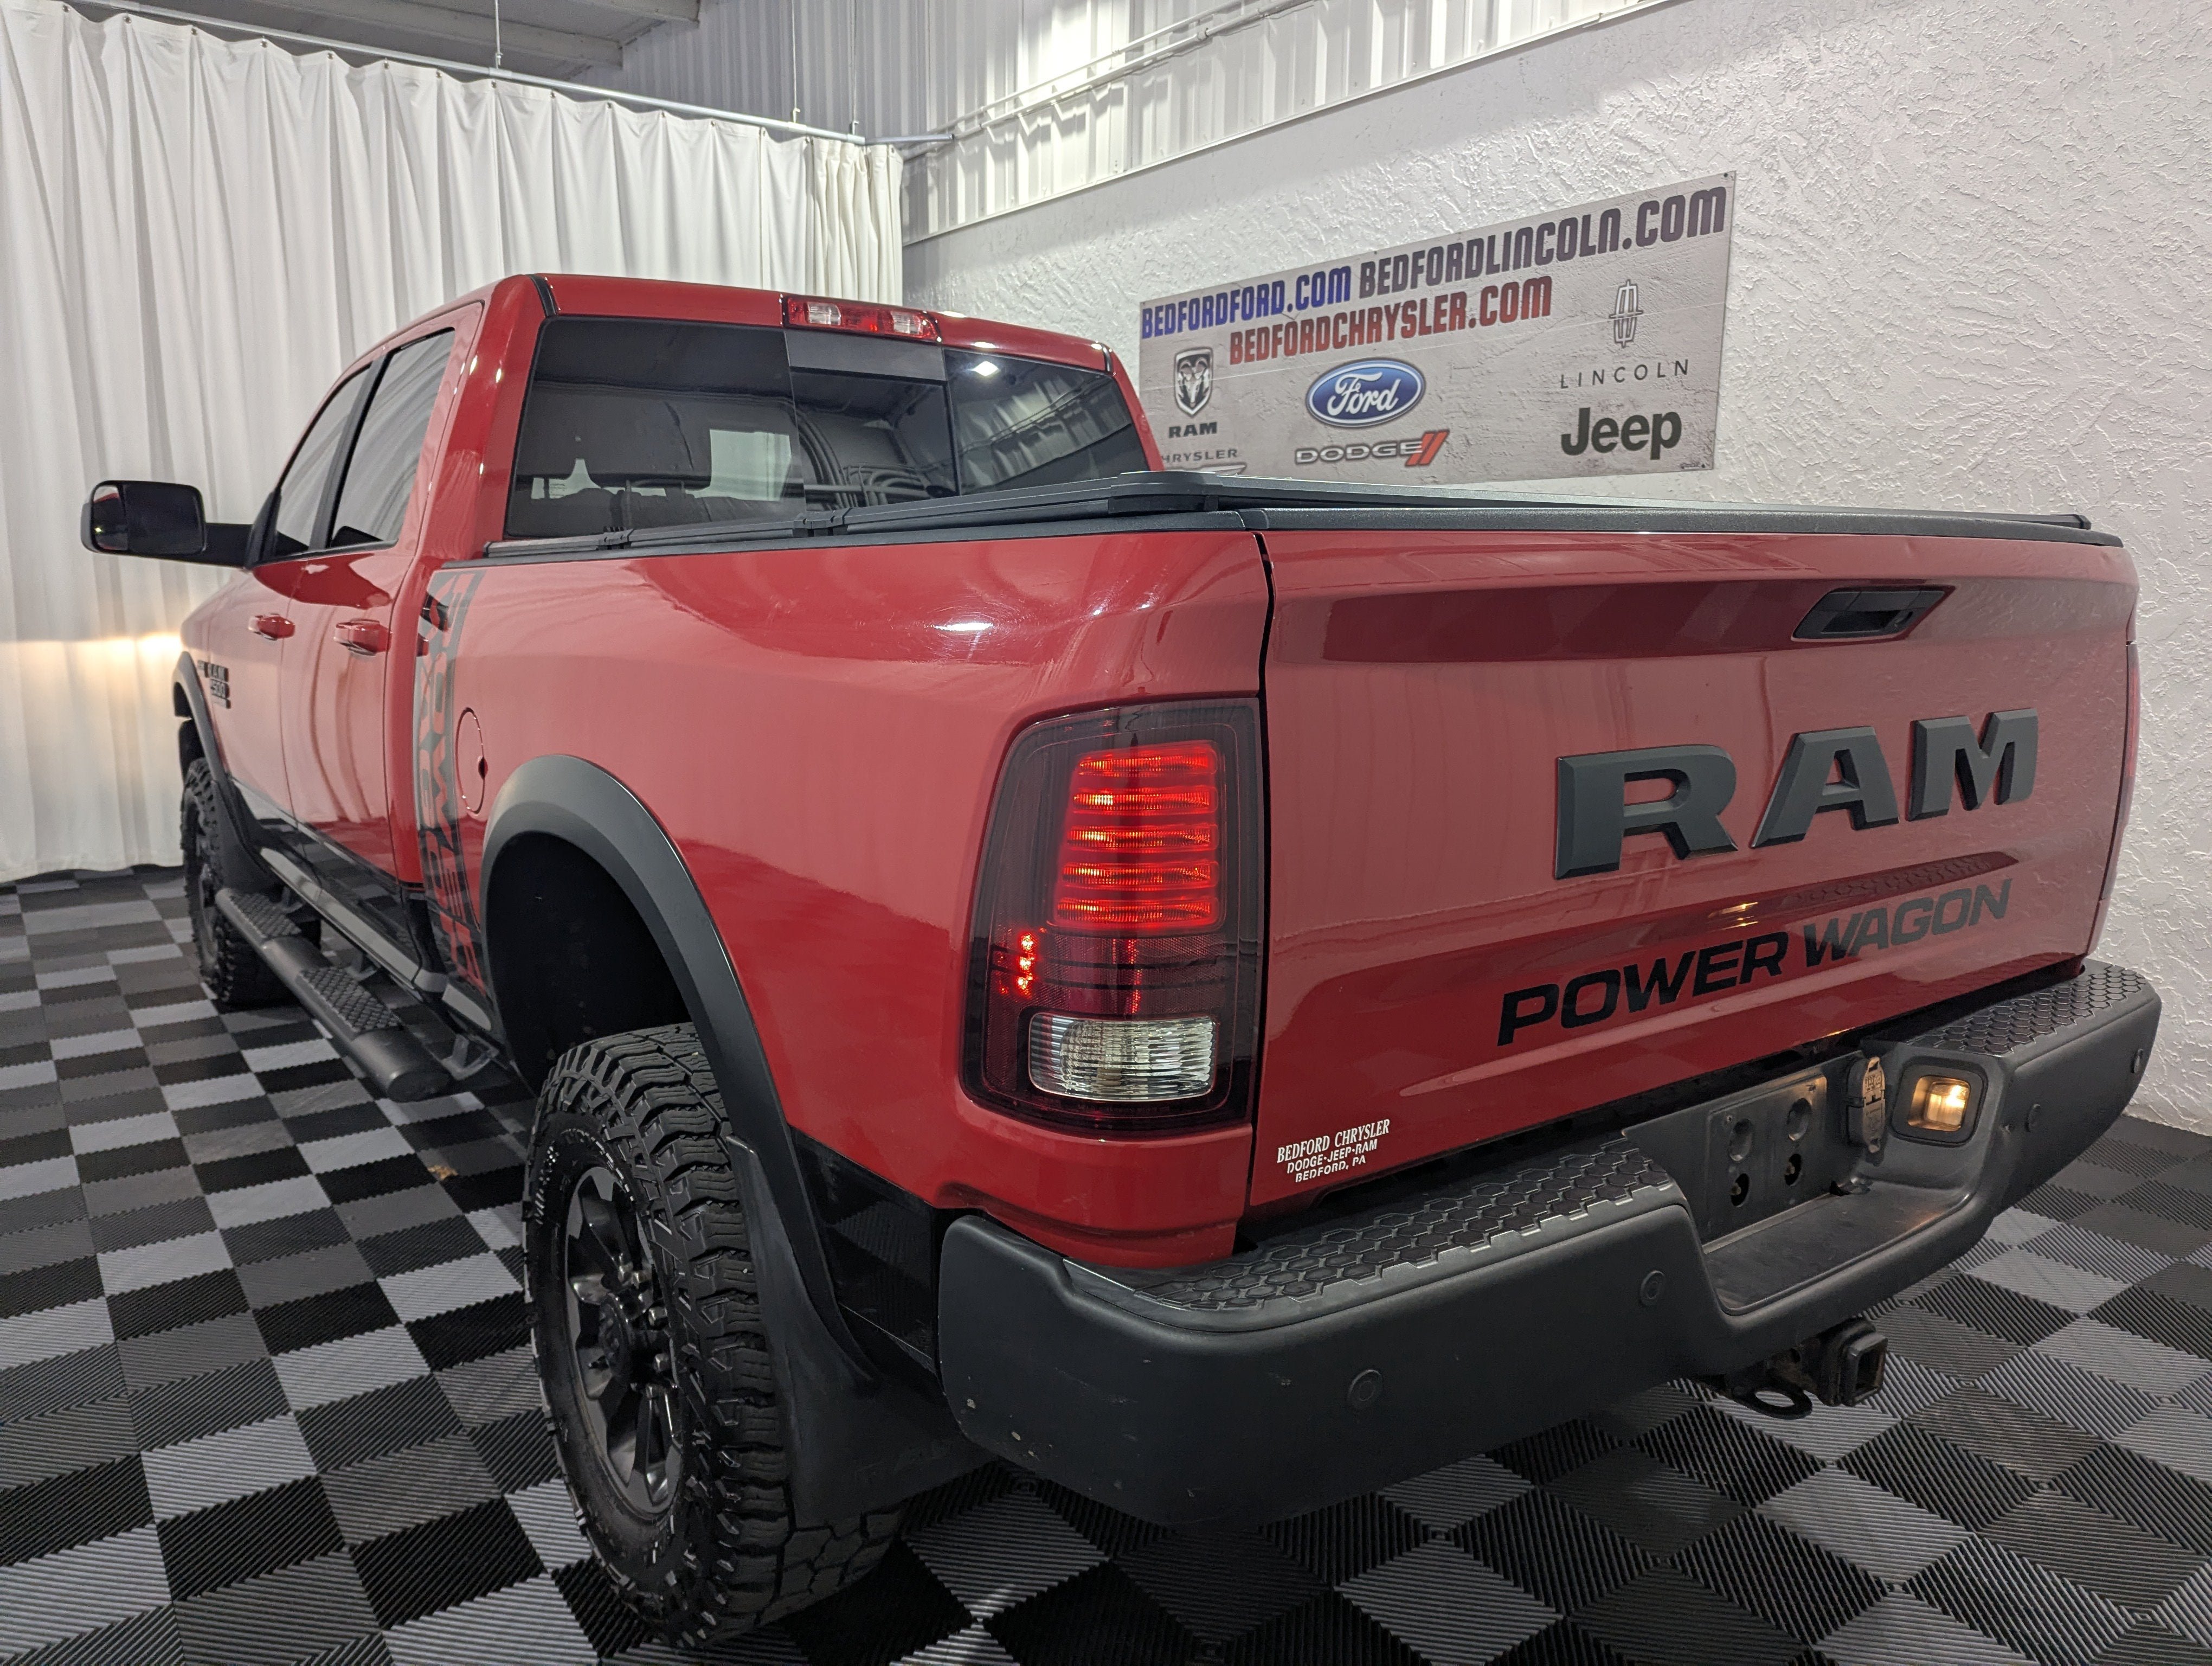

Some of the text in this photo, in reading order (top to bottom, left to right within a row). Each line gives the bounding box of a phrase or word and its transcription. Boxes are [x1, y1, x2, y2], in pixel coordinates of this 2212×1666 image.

[1142, 186, 1727, 339] BEDFORDFORD.COM BEDFORDLINCOLN.COM
[1230, 275, 1553, 365] BEDFORDCHRYSLER.COM
[1327, 372, 1401, 416] Ford
[1560, 359, 1688, 389] LINCOLN
[1168, 422, 1218, 439] RAM
[1295, 438, 1424, 465] DODGE
[1561, 407, 1682, 460] Jeep
[1161, 449, 1238, 463] HRYSLER
[1555, 708, 2039, 880] RAM
[1498, 879, 2012, 1047] POWER WAGON
[1277, 1119, 1390, 1163] BEDFORD CHRYSLER
[1295, 1155, 1366, 1183] BEDFORD, PA
